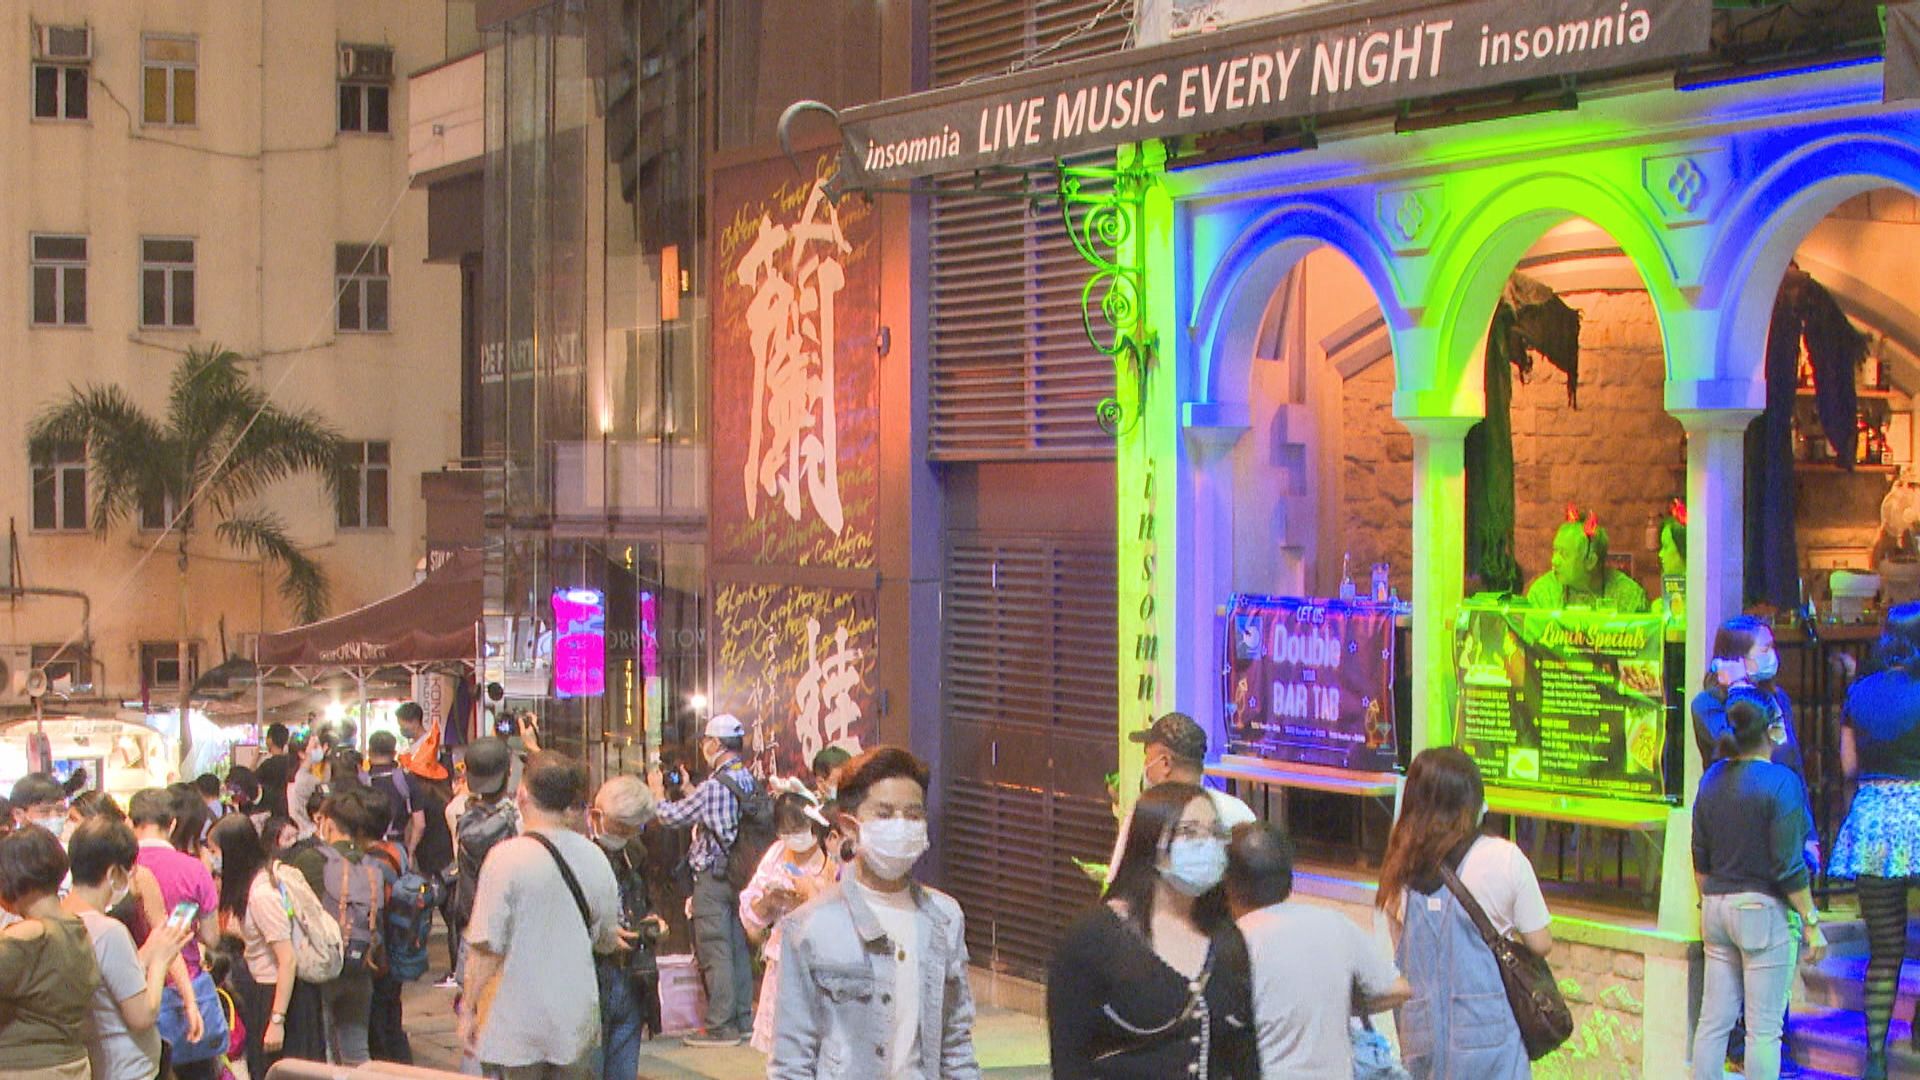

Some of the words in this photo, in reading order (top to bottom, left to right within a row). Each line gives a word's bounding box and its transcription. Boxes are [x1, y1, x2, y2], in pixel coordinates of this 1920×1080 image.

[864, 124, 961, 171] insomnia
[978, 97, 1045, 153] LIVE
[1053, 74, 1167, 140] MUSIC
[1178, 48, 1301, 118] EVERY
[1310, 20, 1453, 96] NIGHT
[1479, 2, 1651, 67] insomnia
[1135, 457, 1159, 723] insomn
[1273, 624, 1341, 668] Double
[1540, 621, 1585, 647] Lunch
[1586, 624, 1645, 654] Specials
[1273, 681, 1308, 718] BAR
[1312, 686, 1340, 721] TAB
